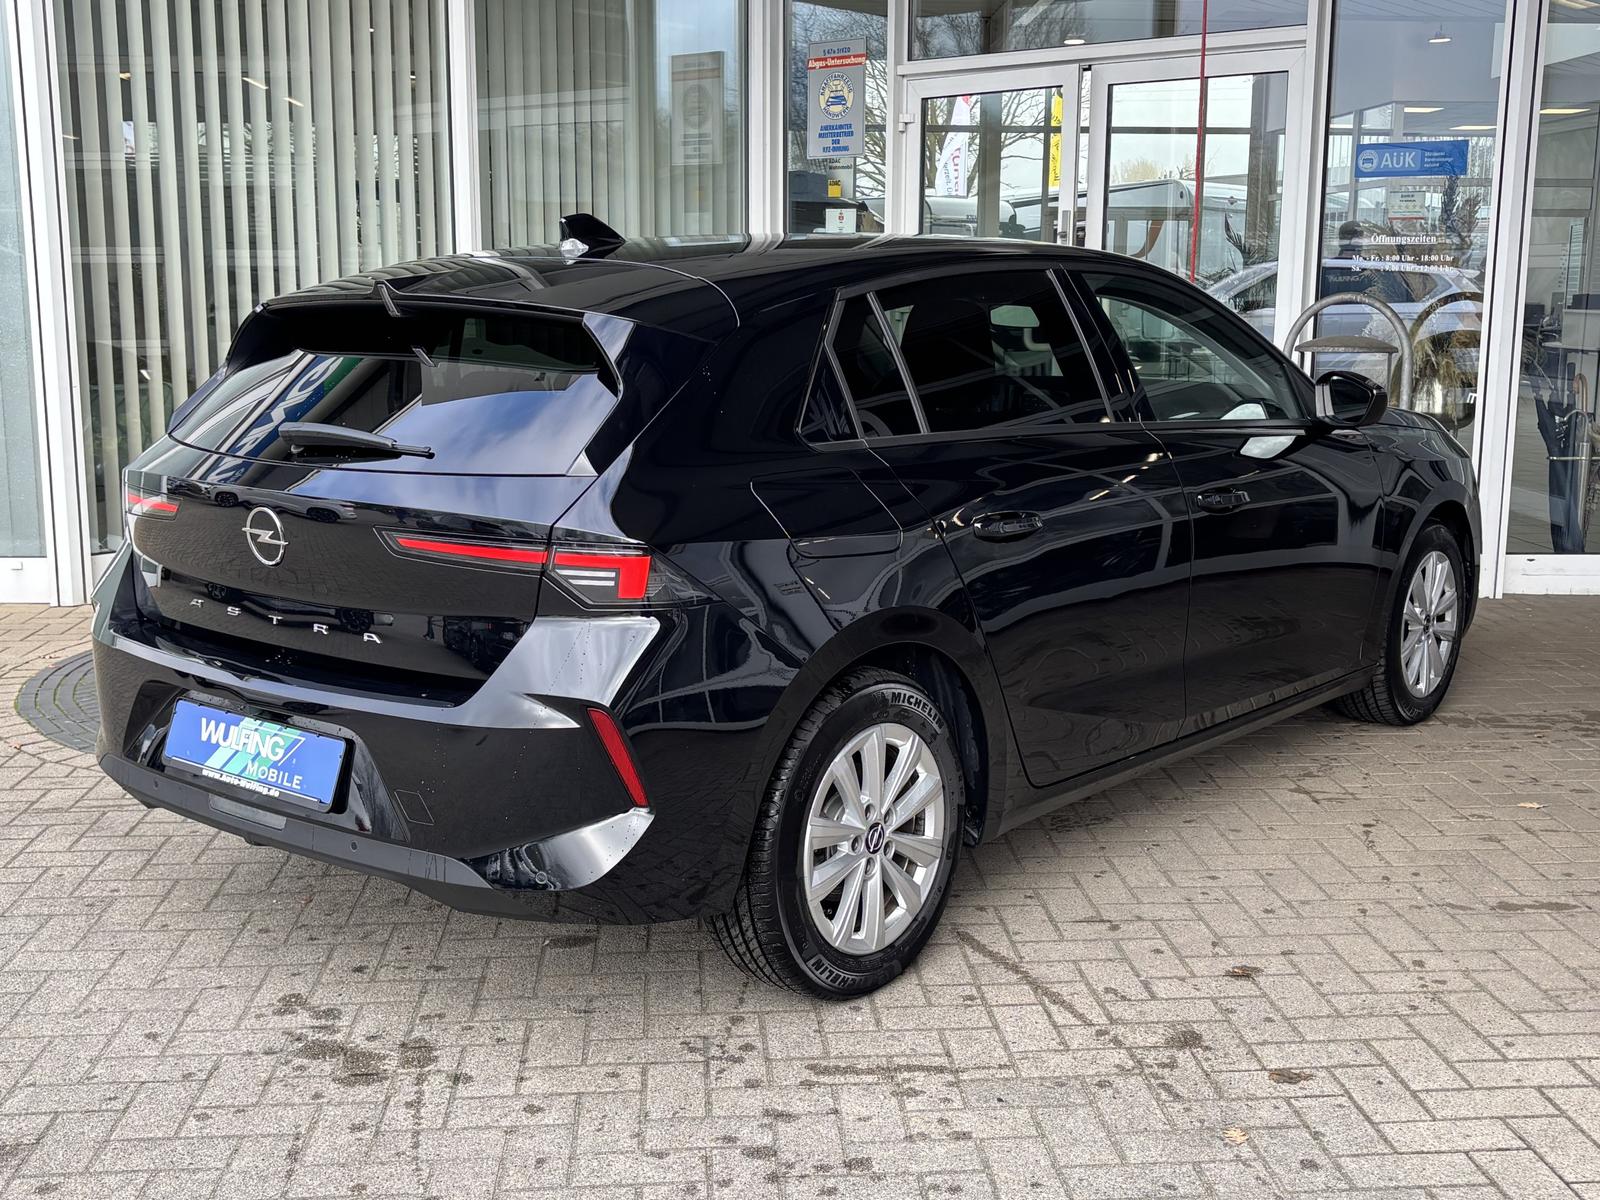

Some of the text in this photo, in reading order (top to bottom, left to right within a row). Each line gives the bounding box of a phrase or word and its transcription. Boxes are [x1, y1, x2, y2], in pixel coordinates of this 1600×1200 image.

[808, 56, 866, 69] Abgas-Untersuchung
[1380, 151, 1416, 168] AÜK
[1370, 234, 1437, 244] Öffnungszeiten
[189, 598, 382, 645] ASTRA
[891, 691, 945, 730] MICHELIN
[200, 717, 286, 762] WULFING
[246, 760, 303, 790] MOBILE
